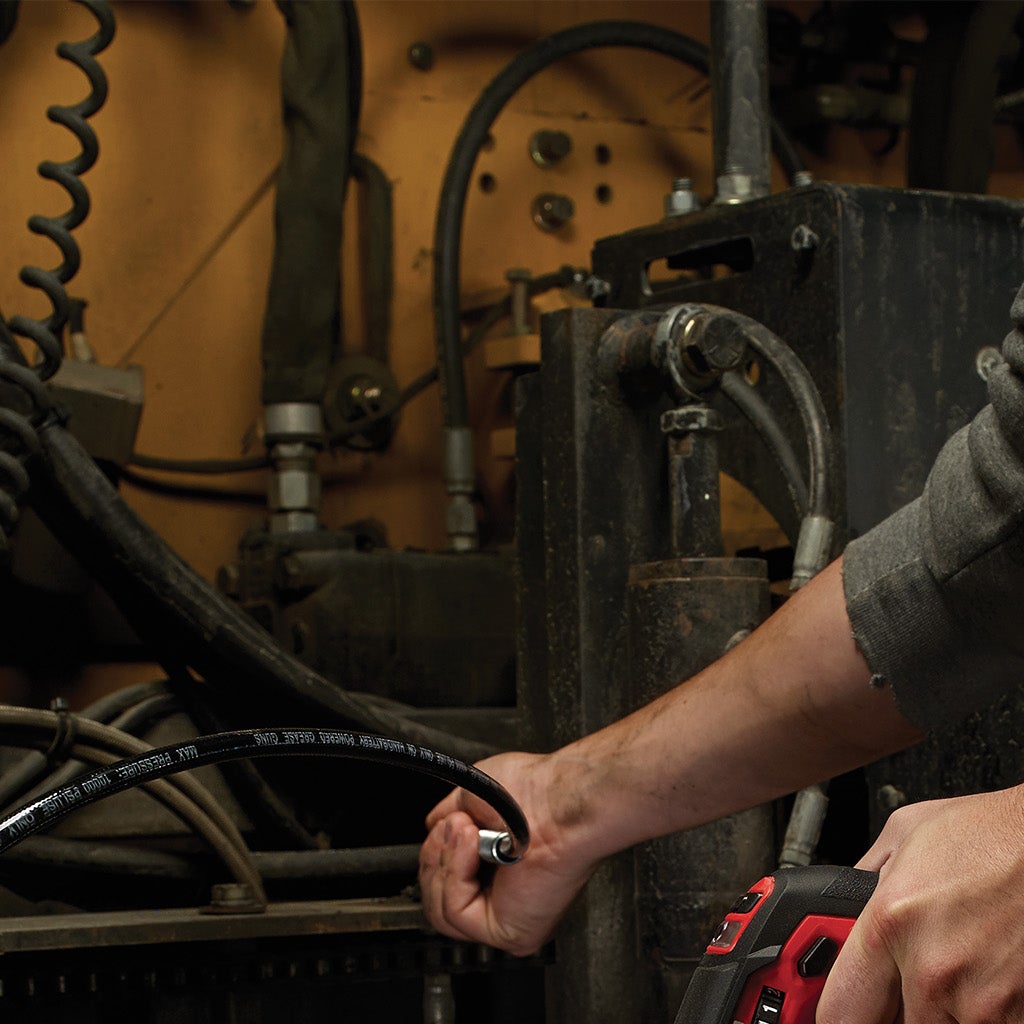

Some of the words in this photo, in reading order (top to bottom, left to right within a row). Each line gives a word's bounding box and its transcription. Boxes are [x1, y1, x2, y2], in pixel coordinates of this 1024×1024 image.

[253, 732, 278, 746] GUNS
[282, 731, 315, 744] GREASE
[176, 745, 199, 760] MAX
